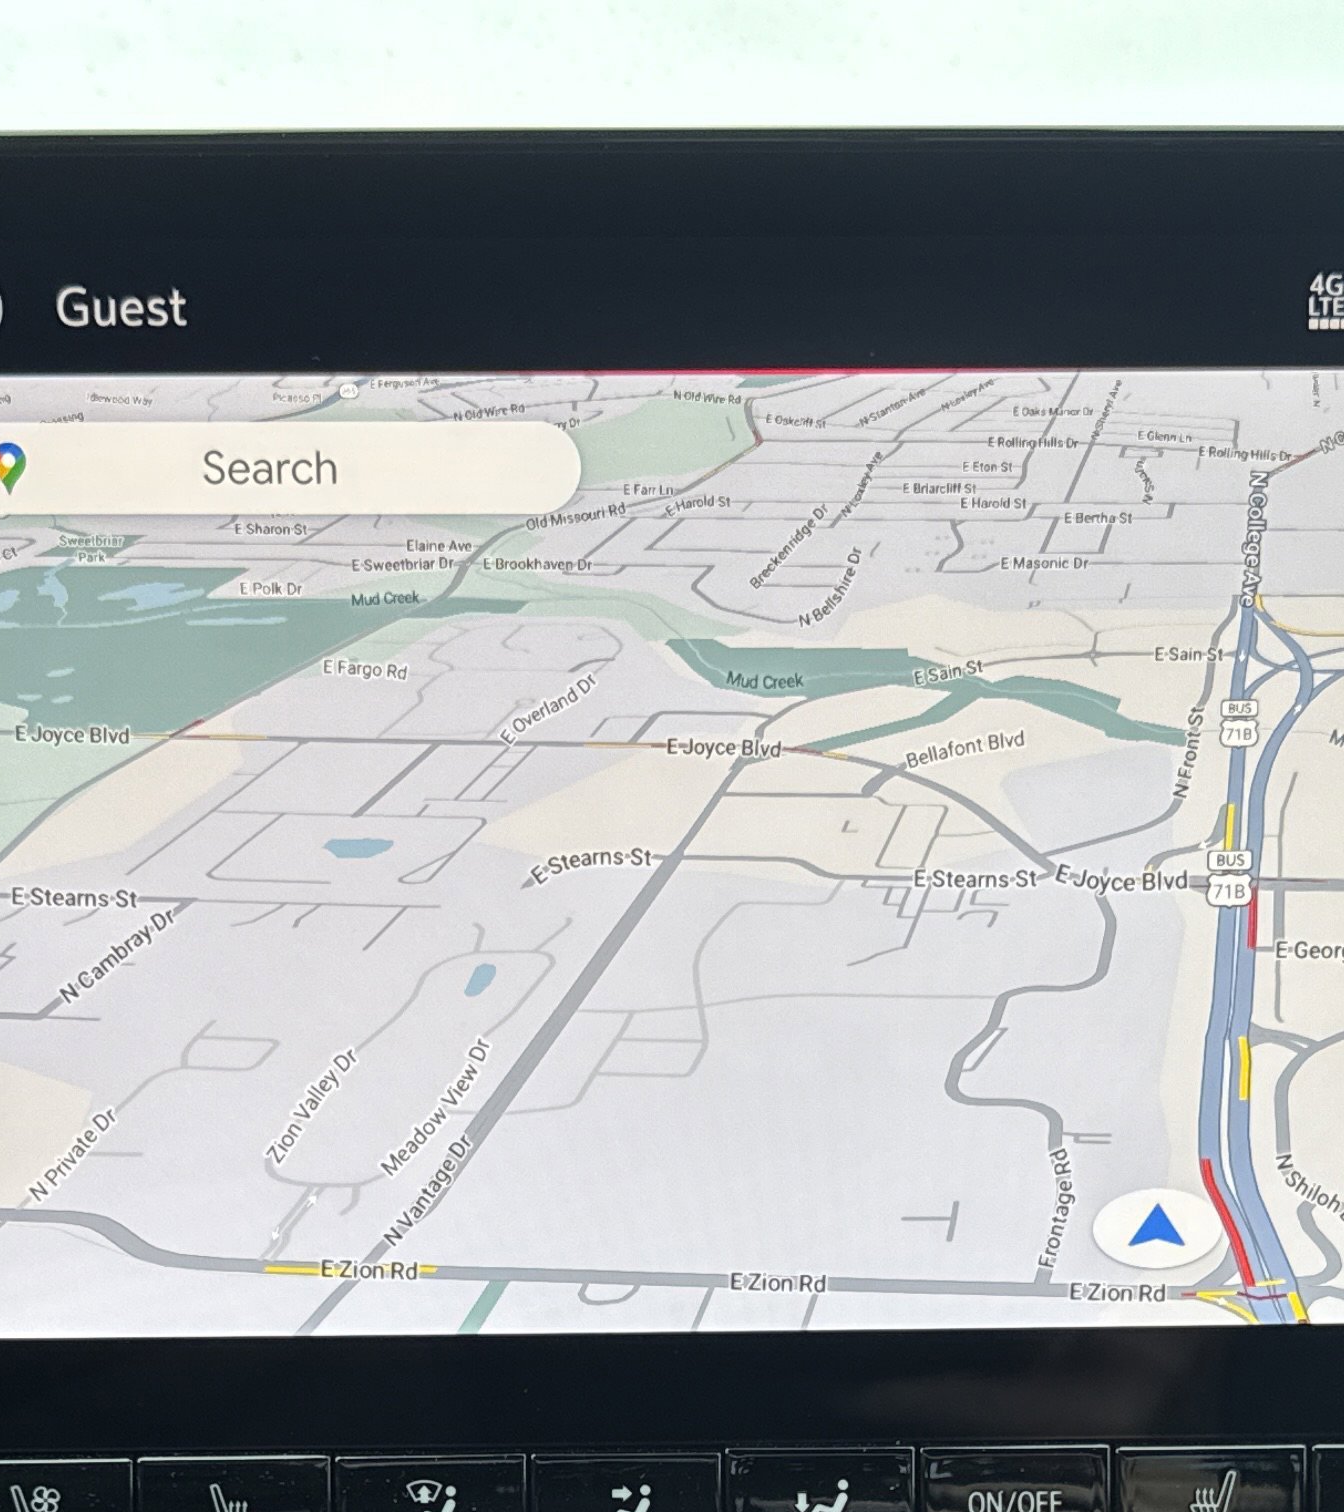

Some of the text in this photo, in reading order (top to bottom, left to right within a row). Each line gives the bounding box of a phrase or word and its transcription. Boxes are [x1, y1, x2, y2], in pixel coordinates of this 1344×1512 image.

[1310, 273, 1344, 295] 4G
[57, 286, 188, 327] Guest
[1320, 438, 1335, 453] N
[200, 450, 338, 485] Search
[525, 503, 627, 530] Old Missouri Rd
[235, 524, 308, 535] E Sharon St
[1239, 470, 1268, 606] N College Ave
[59, 535, 124, 547] Sweetbriar
[407, 540, 472, 552] Elaine Ave
[750, 503, 830, 589] Breckenridge Dr
[78, 552, 106, 562] Park
[352, 557, 455, 573] E Sweetbriar Dr
[483, 558, 592, 571] E Brookhaven Dr
[1000, 558, 1089, 570] E Masonic Dr
[240, 583, 302, 595] E Polk Dr
[799, 547, 863, 627] N Bellshire Dr
[351, 592, 420, 606] Mud Creek
[1155, 648, 1223, 661] E Sain St
[323, 660, 408, 680] E Fargo Rd
[914, 660, 984, 685] E Sain St
[726, 672, 804, 689] Mud Creek
[499, 673, 598, 746] E Overland Dr
[1229, 703, 1253, 714] BUS
[15, 726, 130, 747] E Joyce Blvd
[1226, 728, 1253, 741] 71B
[667, 739, 782, 760] E Joyce Blvd
[906, 730, 1025, 769] Bellafont Blvd
[1173, 707, 1205, 799] N Front St
[530, 849, 651, 885] E Stearns St
[1216, 854, 1245, 867] BUS
[914, 870, 1037, 887] E Stearns St
[1055, 864, 1188, 896] E Joyce Blvd
[11, 888, 138, 907] E Stearns St
[1213, 884, 1246, 899] 71B
[59, 911, 176, 1004] N Cambray Dr
[1275, 941, 1288, 958] E
[265, 1049, 359, 1165] Zion Valley Dr
[380, 1038, 491, 1177] Meadow View Dr
[28, 1108, 117, 1202] N Private Dr
[383, 1134, 472, 1247] N Vantage Dr
[1274, 1154, 1293, 1170] N
[1285, 1170, 1342, 1213] Shiloh
[1037, 1148, 1076, 1268] Frontage Rd
[320, 1260, 418, 1280] E Zion Rd
[730, 1273, 827, 1292] E Zion Rd
[1069, 1283, 1167, 1302] E Zion Rd
